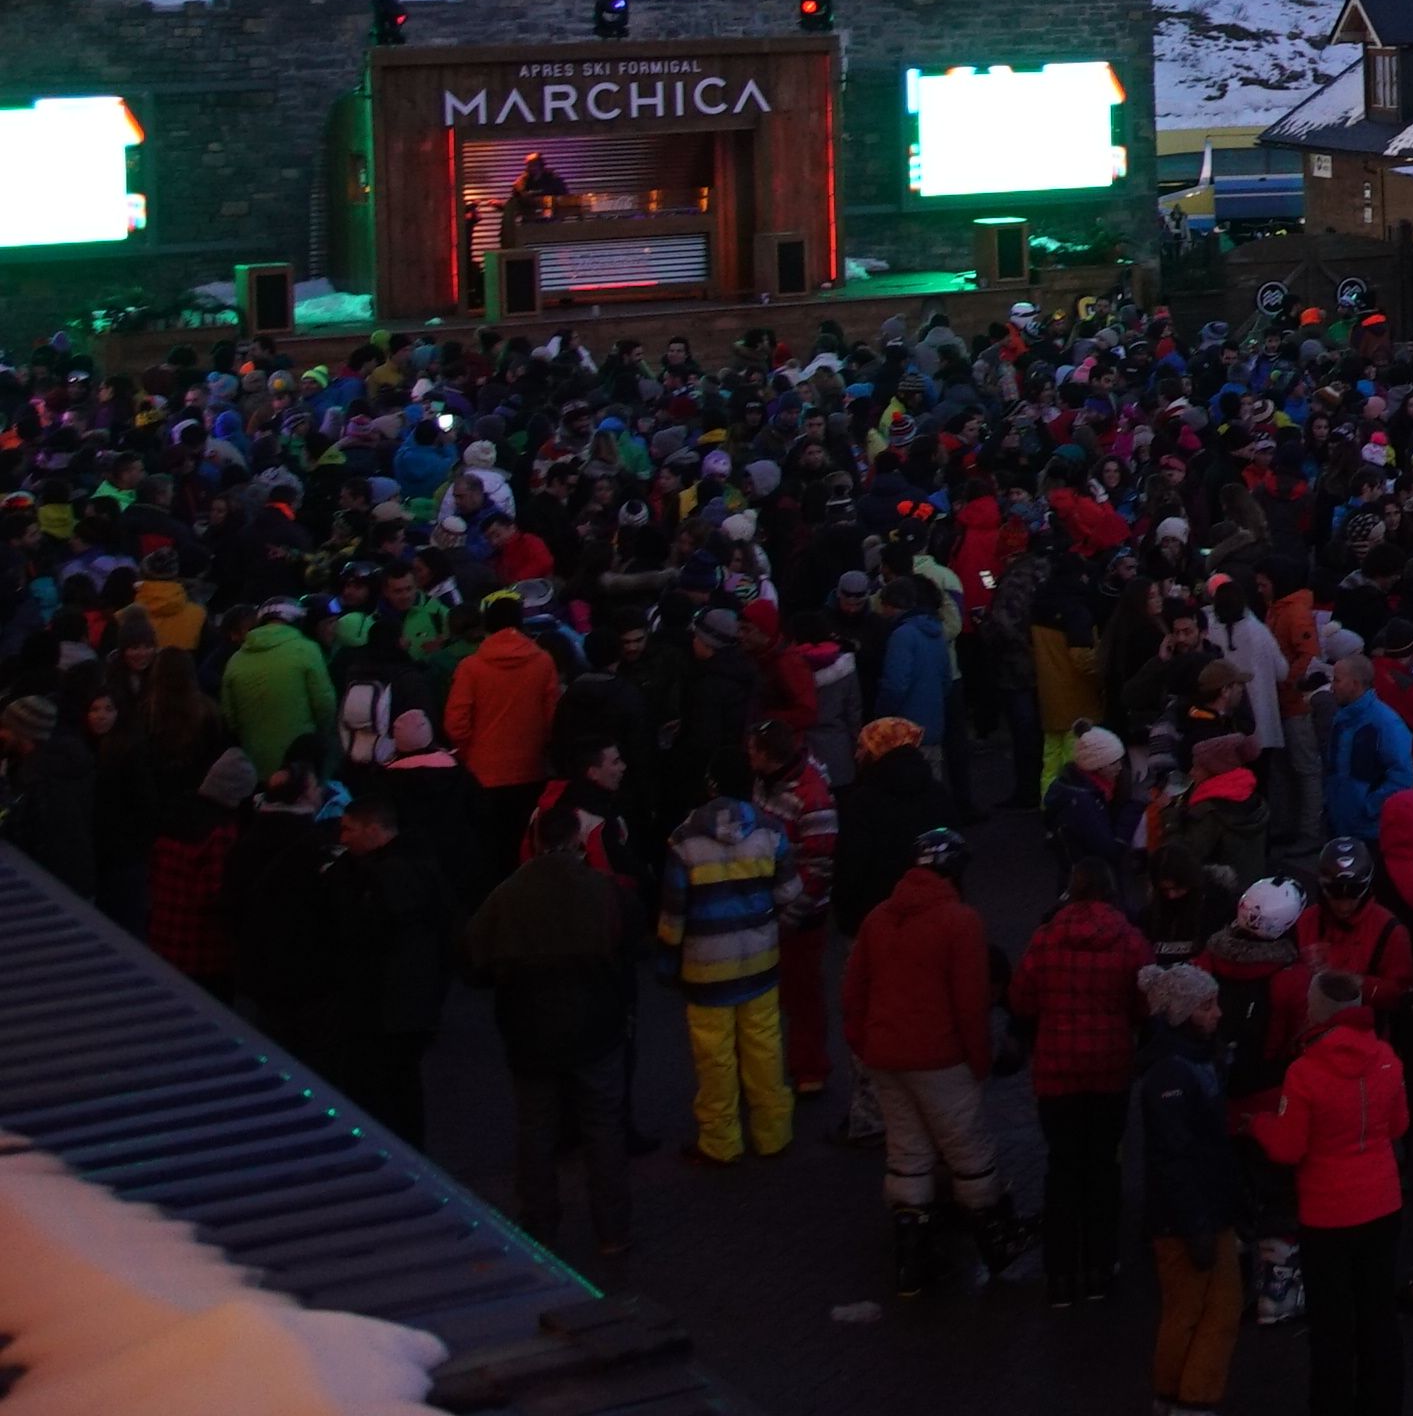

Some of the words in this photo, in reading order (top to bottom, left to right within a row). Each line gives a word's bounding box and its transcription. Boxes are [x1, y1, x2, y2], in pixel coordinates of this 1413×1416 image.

[583, 61, 611, 77] SKI
[618, 59, 703, 76] FORMIGAL
[444, 77, 772, 126] MARCHICA
